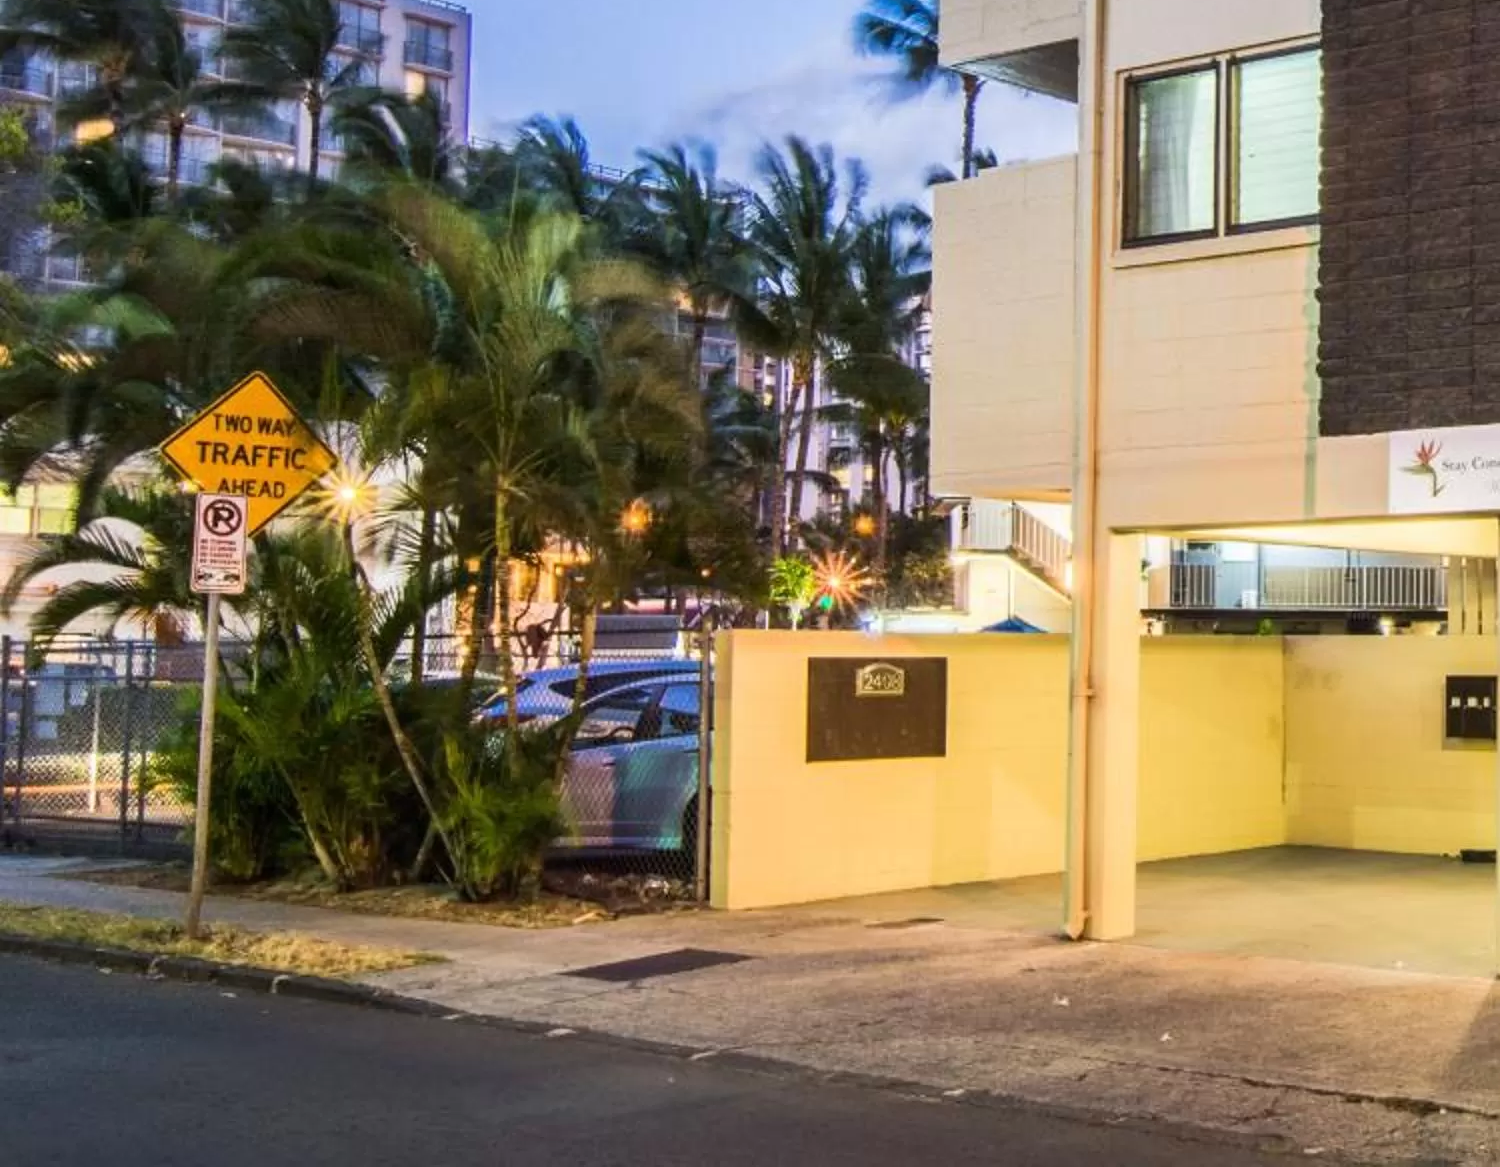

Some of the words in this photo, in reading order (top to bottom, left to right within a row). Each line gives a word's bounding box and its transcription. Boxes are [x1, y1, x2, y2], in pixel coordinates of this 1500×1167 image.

[213, 413, 253, 434] TWO
[257, 416, 297, 438] WAY
[196, 440, 307, 470] TRAFFIC
[1441, 461, 1469, 475] Stay
[217, 478, 285, 499] AHEAD
[863, 672, 901, 690] 2408
